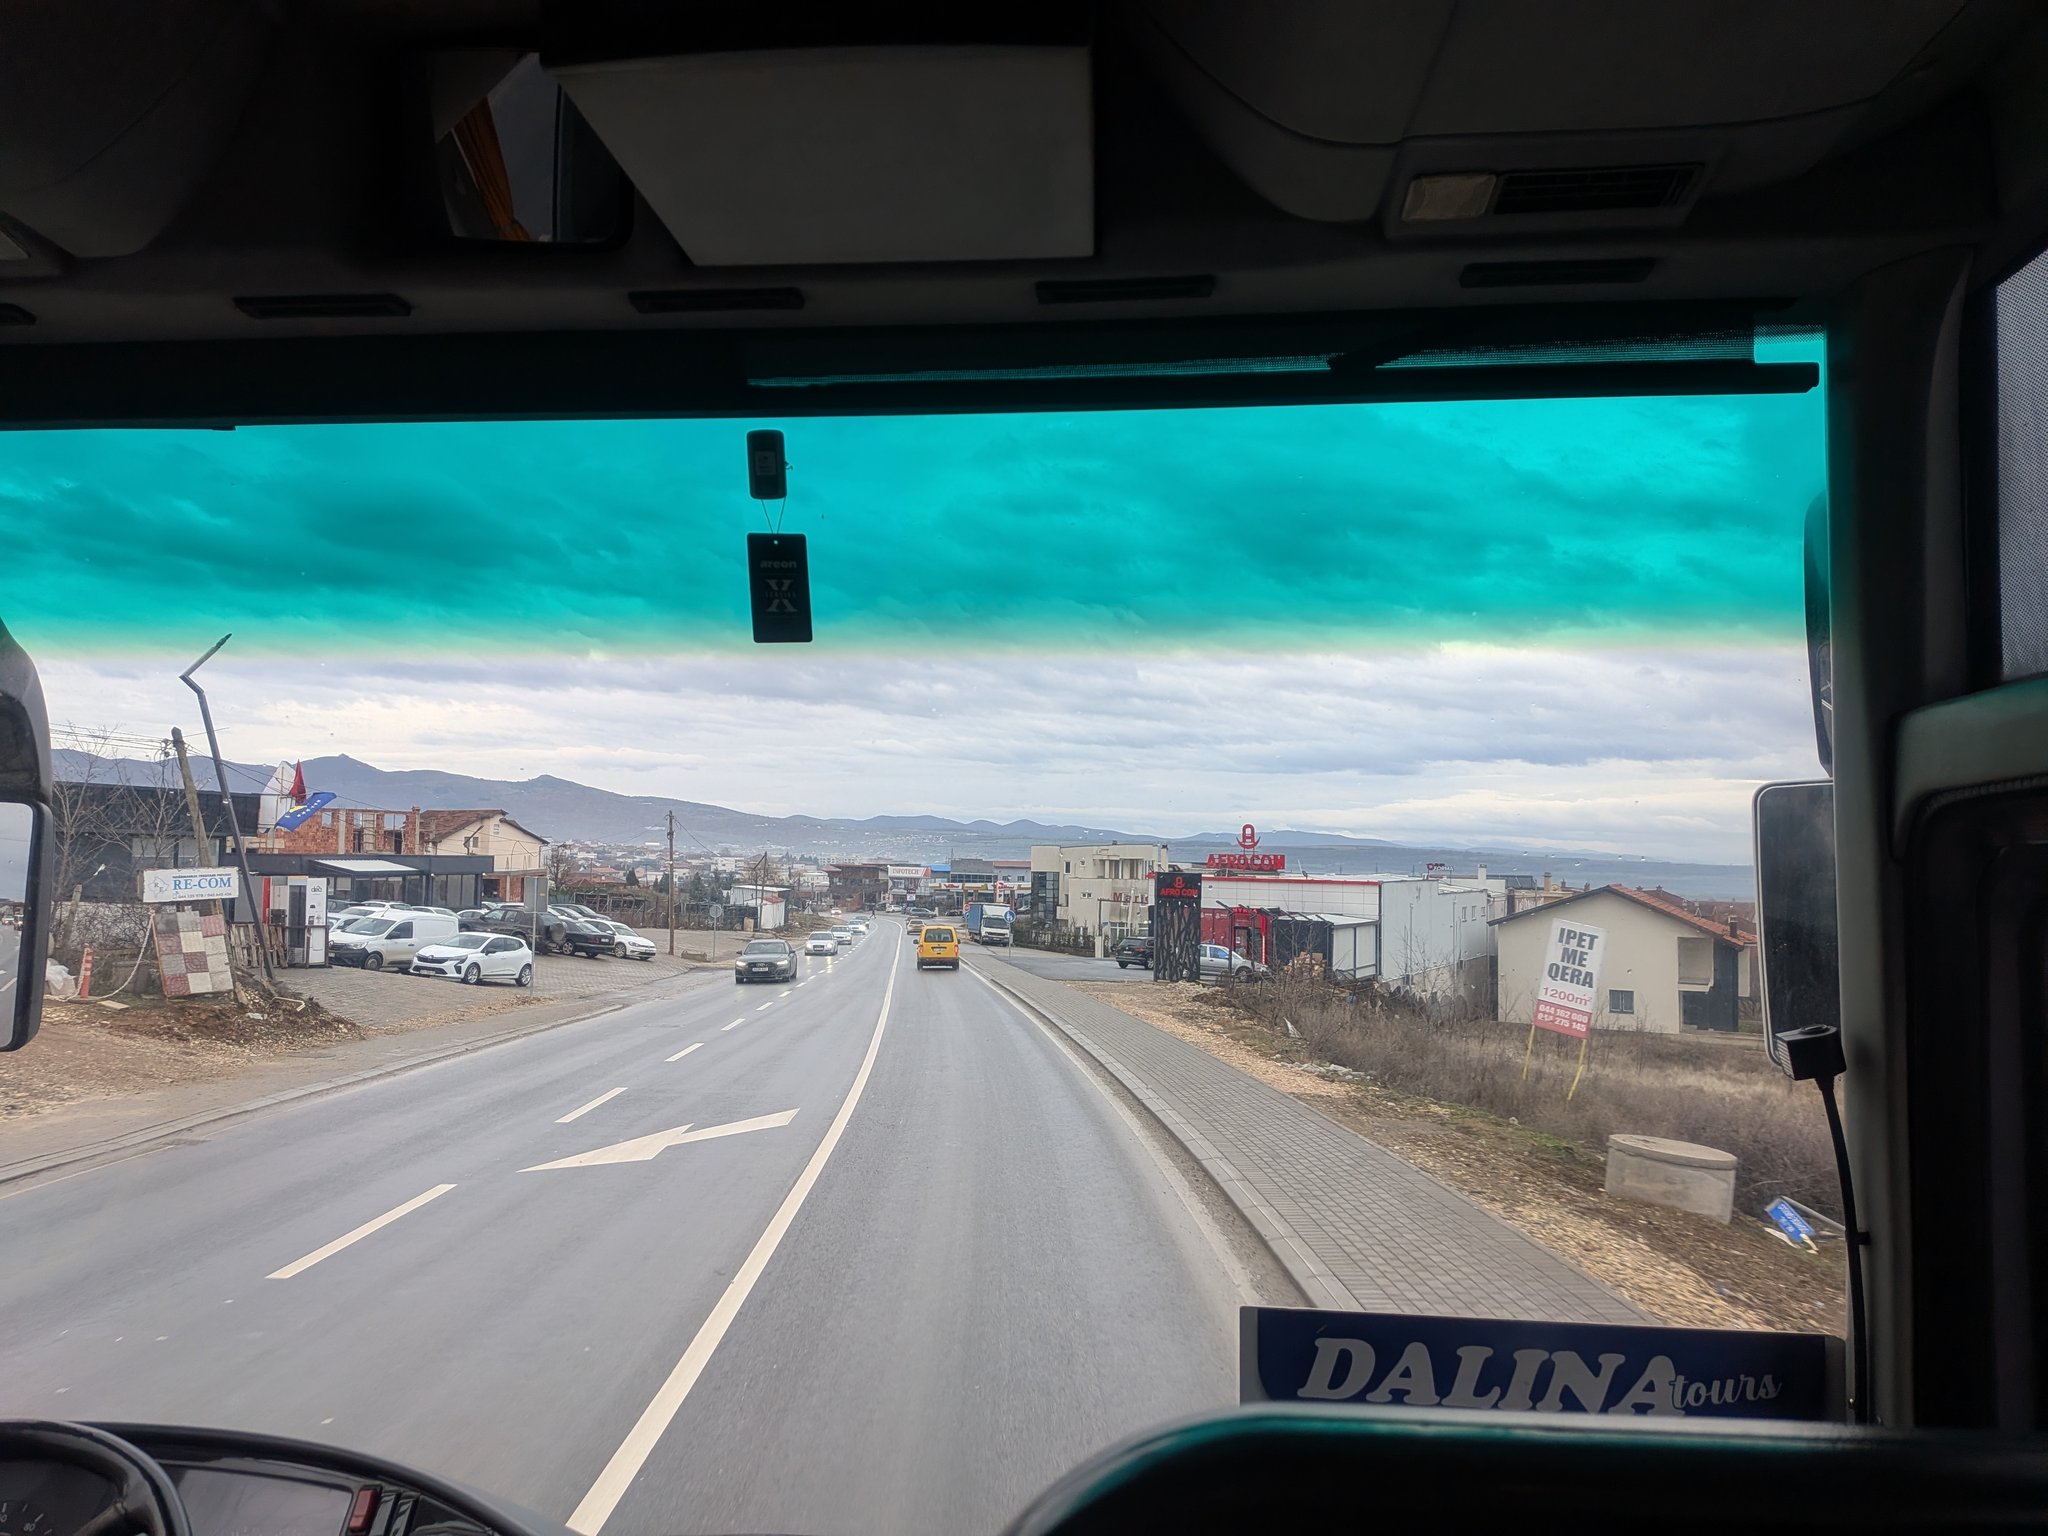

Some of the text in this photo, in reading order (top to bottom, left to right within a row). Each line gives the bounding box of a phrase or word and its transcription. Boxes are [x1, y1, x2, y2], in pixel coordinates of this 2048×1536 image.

[760, 560, 797, 569] areon
[172, 877, 232, 891] RE-COM
[1160, 888, 1180, 897] AFRO
[1558, 927, 1599, 951] IPET
[1560, 946, 1589, 968] ME
[1547, 962, 1594, 989] QERA
[1297, 1337, 1783, 1416] DALINA tours
[23, 1522, 36, 1532] 80
